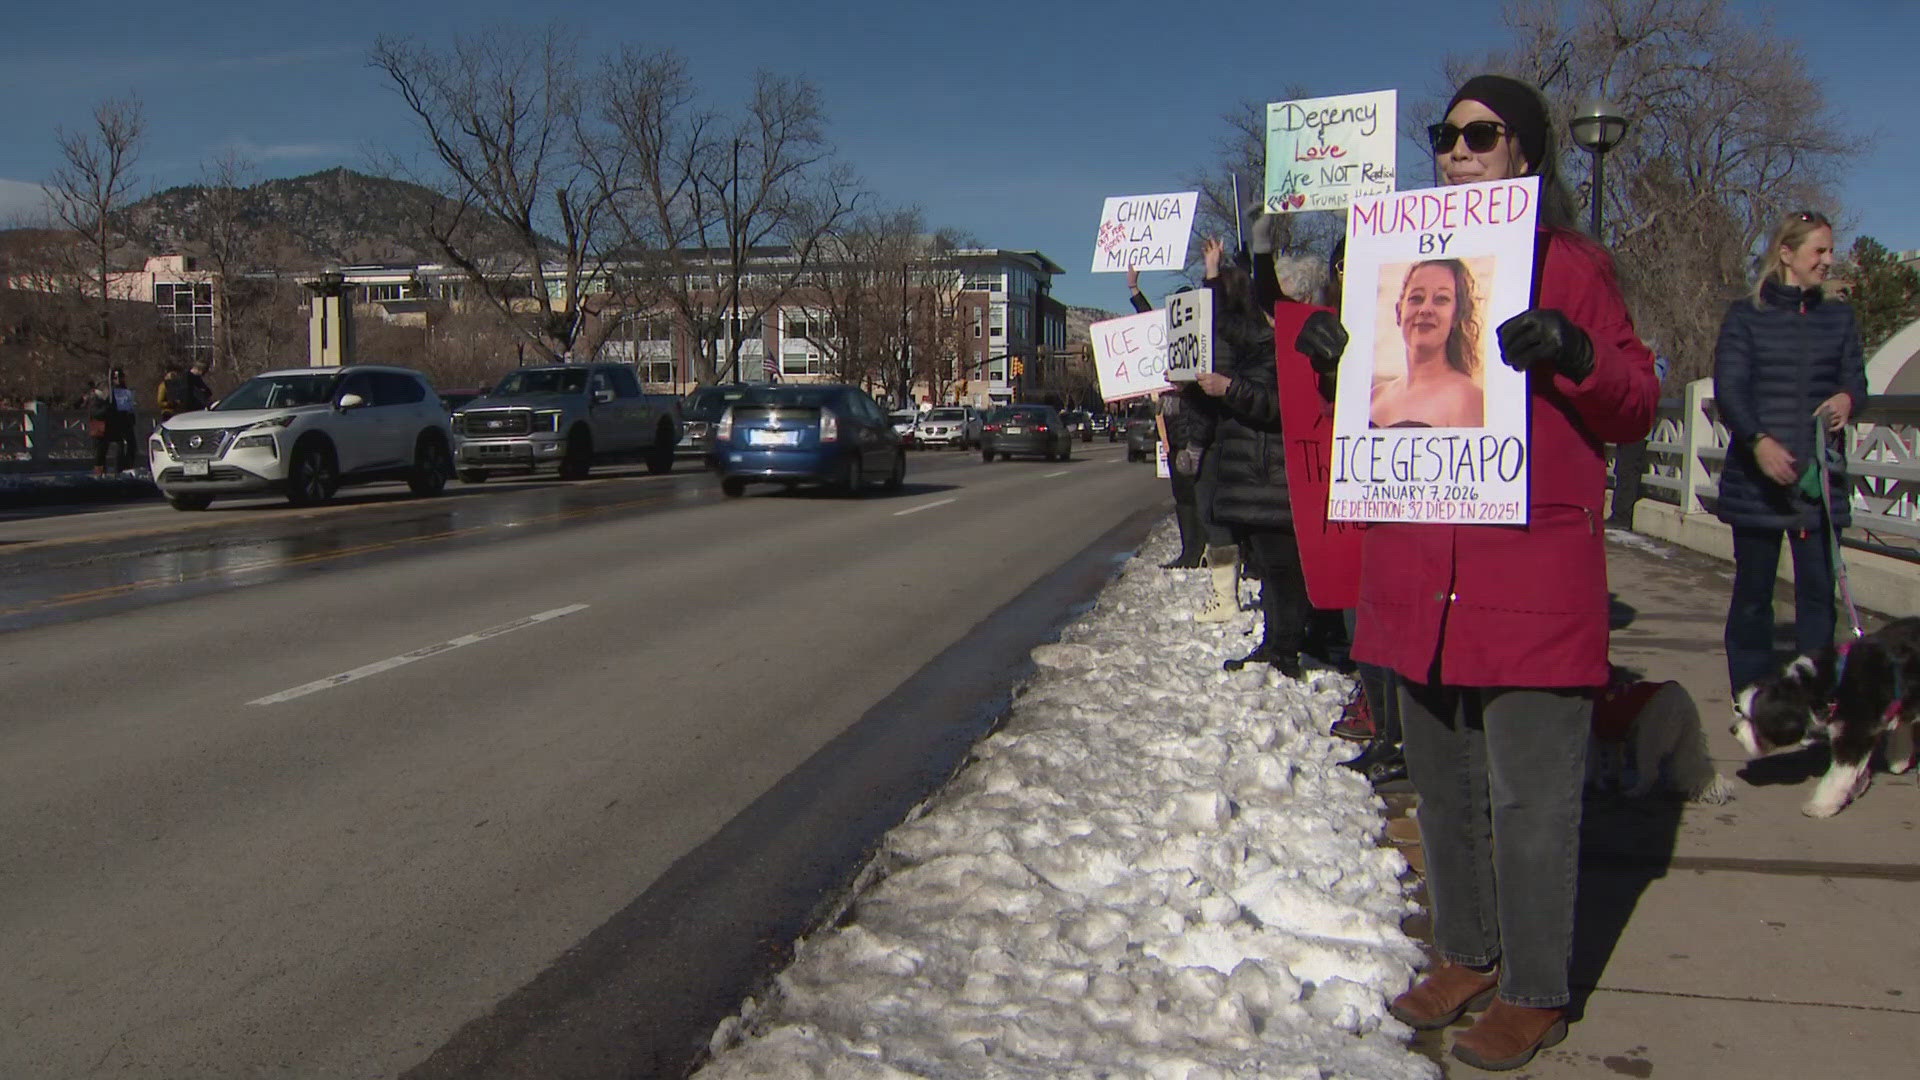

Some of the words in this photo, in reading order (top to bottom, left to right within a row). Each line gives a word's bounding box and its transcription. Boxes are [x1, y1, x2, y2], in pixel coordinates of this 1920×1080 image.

[1271, 102, 1377, 136] Decency
[1294, 138, 1347, 162] Love
[1281, 170, 1313, 192] Are
[1319, 164, 1358, 187] NOT
[1117, 198, 1182, 222] CHINGA
[1352, 185, 1530, 238] MURDERED
[1130, 225, 1153, 242] LA
[1418, 232, 1453, 254] BY
[1169, 298, 1182, 330] ICE
[1104, 326, 1140, 358] ICE
[1168, 333, 1199, 371] GESTAPO
[1335, 435, 1387, 483] ICE
[1391, 435, 1525, 484] GESTAPO
[1362, 485, 1425, 500] JANUARY
[1444, 485, 1479, 500] 2026
[1330, 499, 1347, 517] ICE
[1350, 501, 1405, 519] DETENTION:
[1407, 501, 1423, 520] 32
[1426, 501, 1456, 520] DIED
[1460, 502, 1476, 519] IN
[1479, 501, 1519, 520] 2025!
